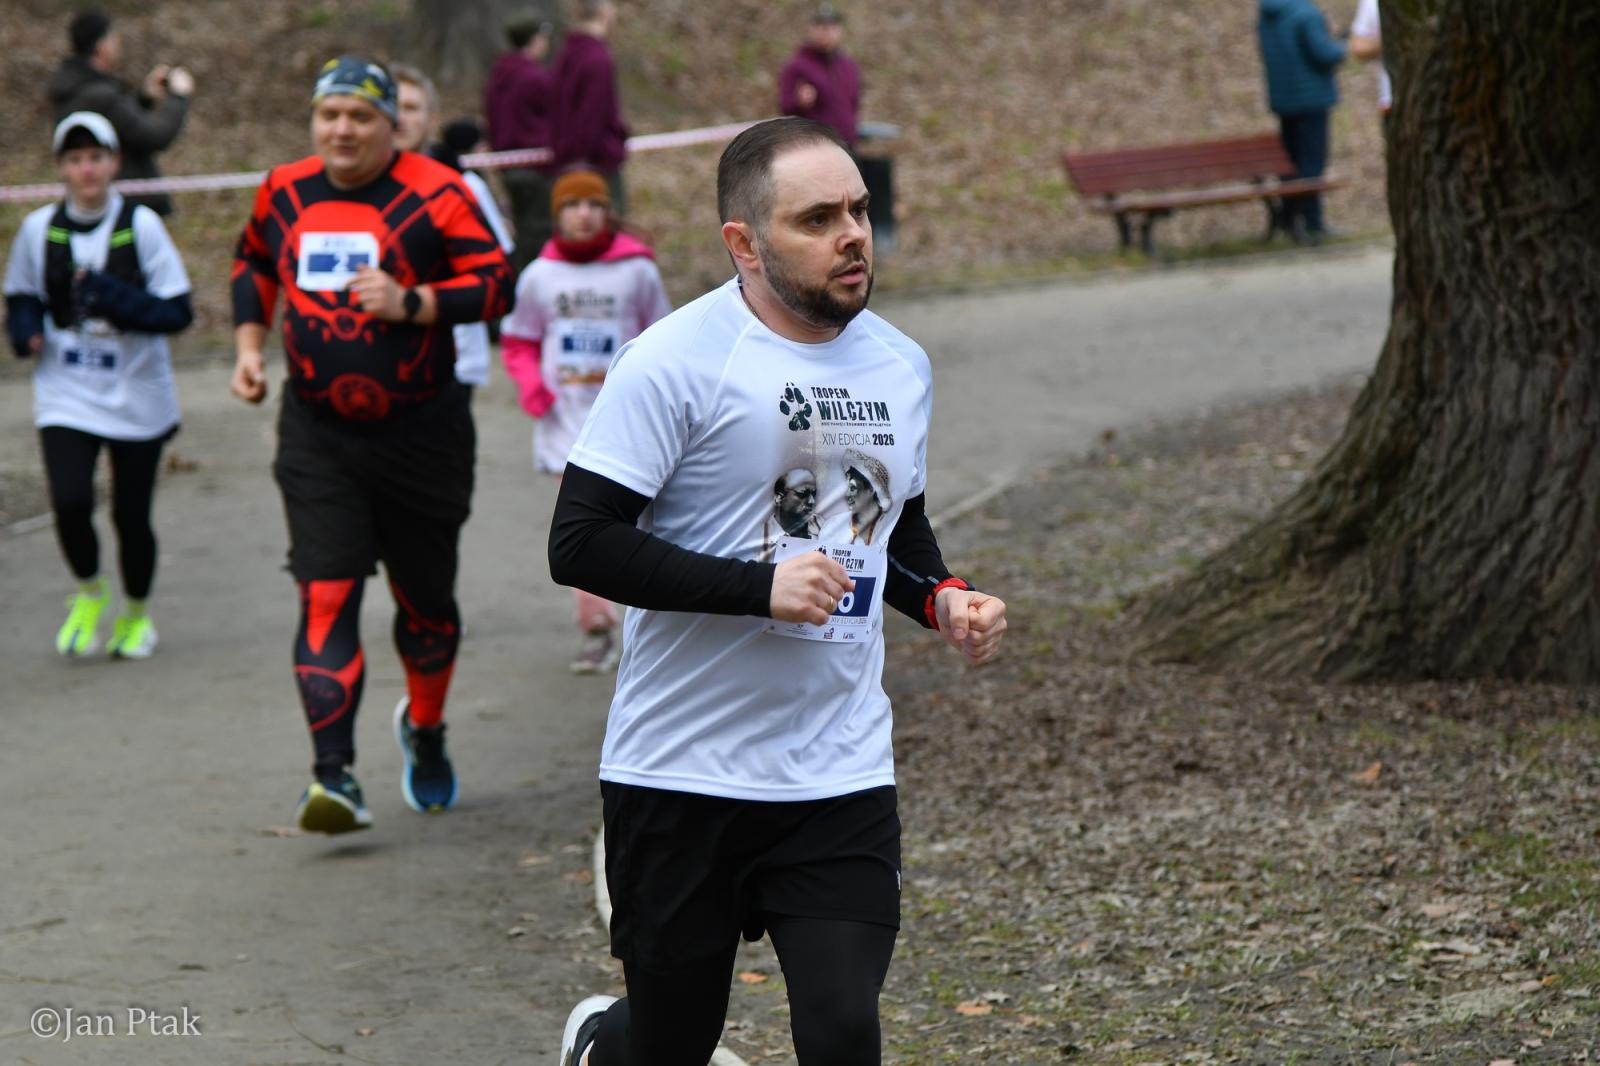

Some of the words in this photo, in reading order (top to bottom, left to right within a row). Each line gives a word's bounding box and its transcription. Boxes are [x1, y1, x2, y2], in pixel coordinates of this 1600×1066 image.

[332, 252, 350, 272] 2
[810, 386, 851, 399] TROPEM
[816, 400, 891, 421] WILCZYM
[822, 432, 837, 446] XIV
[838, 432, 872, 446] EDYCJA
[872, 433, 896, 446] 2026
